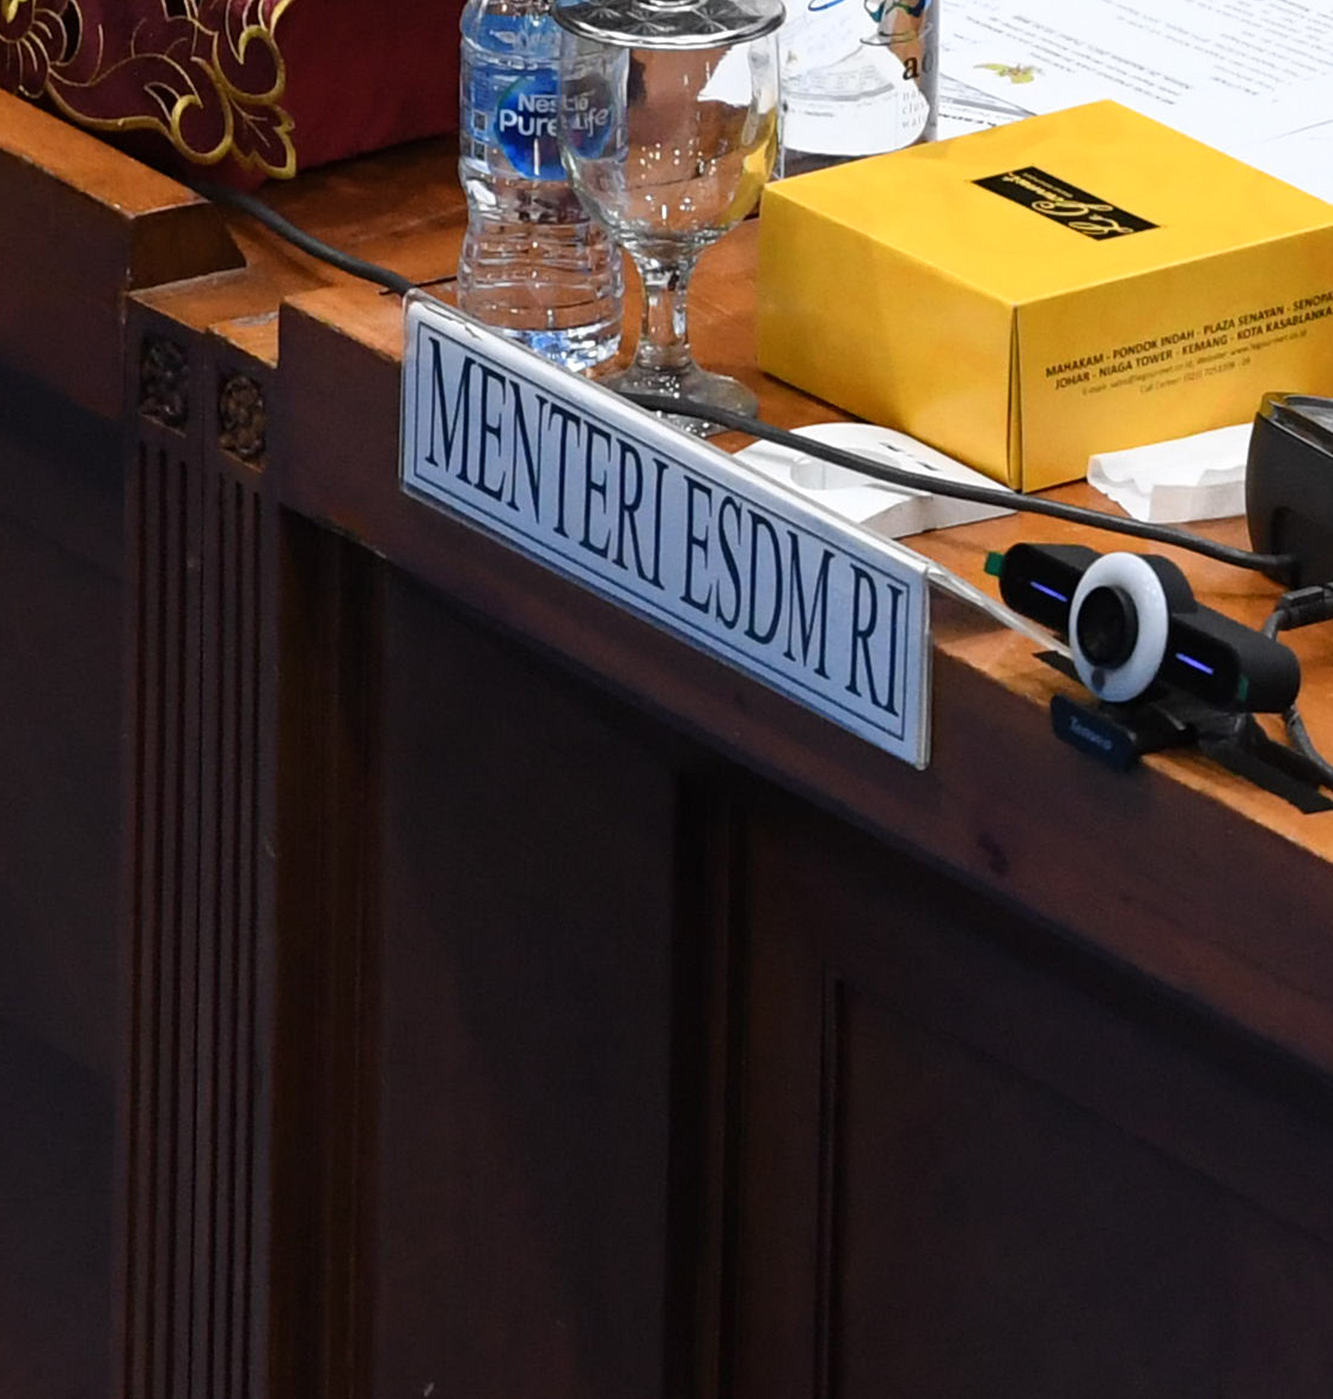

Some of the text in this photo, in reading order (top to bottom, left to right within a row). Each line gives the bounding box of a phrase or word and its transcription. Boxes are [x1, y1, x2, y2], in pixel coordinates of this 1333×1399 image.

[571, 107, 609, 137] Life
[1045, 354, 1104, 378] MAHAKAM
[1112, 340, 1159, 360] PONDOK
[1160, 329, 1195, 346] INDAH
[1203, 319, 1236, 335] PLAZA
[1238, 306, 1285, 326] SENAYAN
[1055, 305, 1333, 390] JOHAR NIAGA TOWER KEMANG KOTA KASABLANKA
[425, 337, 904, 717] MENTERI ESDM RI
